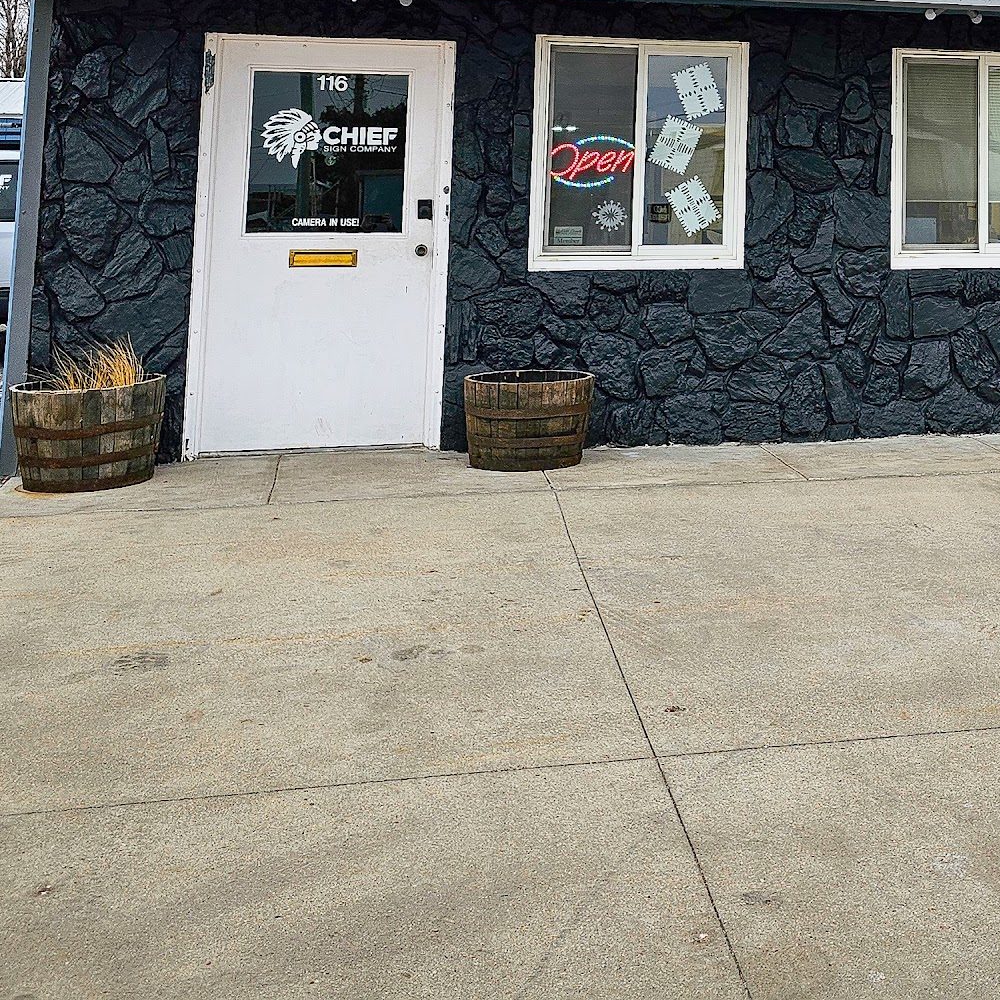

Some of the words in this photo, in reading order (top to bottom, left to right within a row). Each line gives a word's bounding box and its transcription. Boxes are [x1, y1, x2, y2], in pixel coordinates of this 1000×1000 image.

[316, 74, 349, 92] 116
[322, 126, 399, 146] CHIEF
[323, 145, 347, 153] SIGN
[349, 145, 397, 153] COMPANY
[550, 143, 635, 179] Open
[291, 217, 327, 227] CAMERA
[328, 217, 339, 227] IN
[340, 217, 360, 227] USE!
